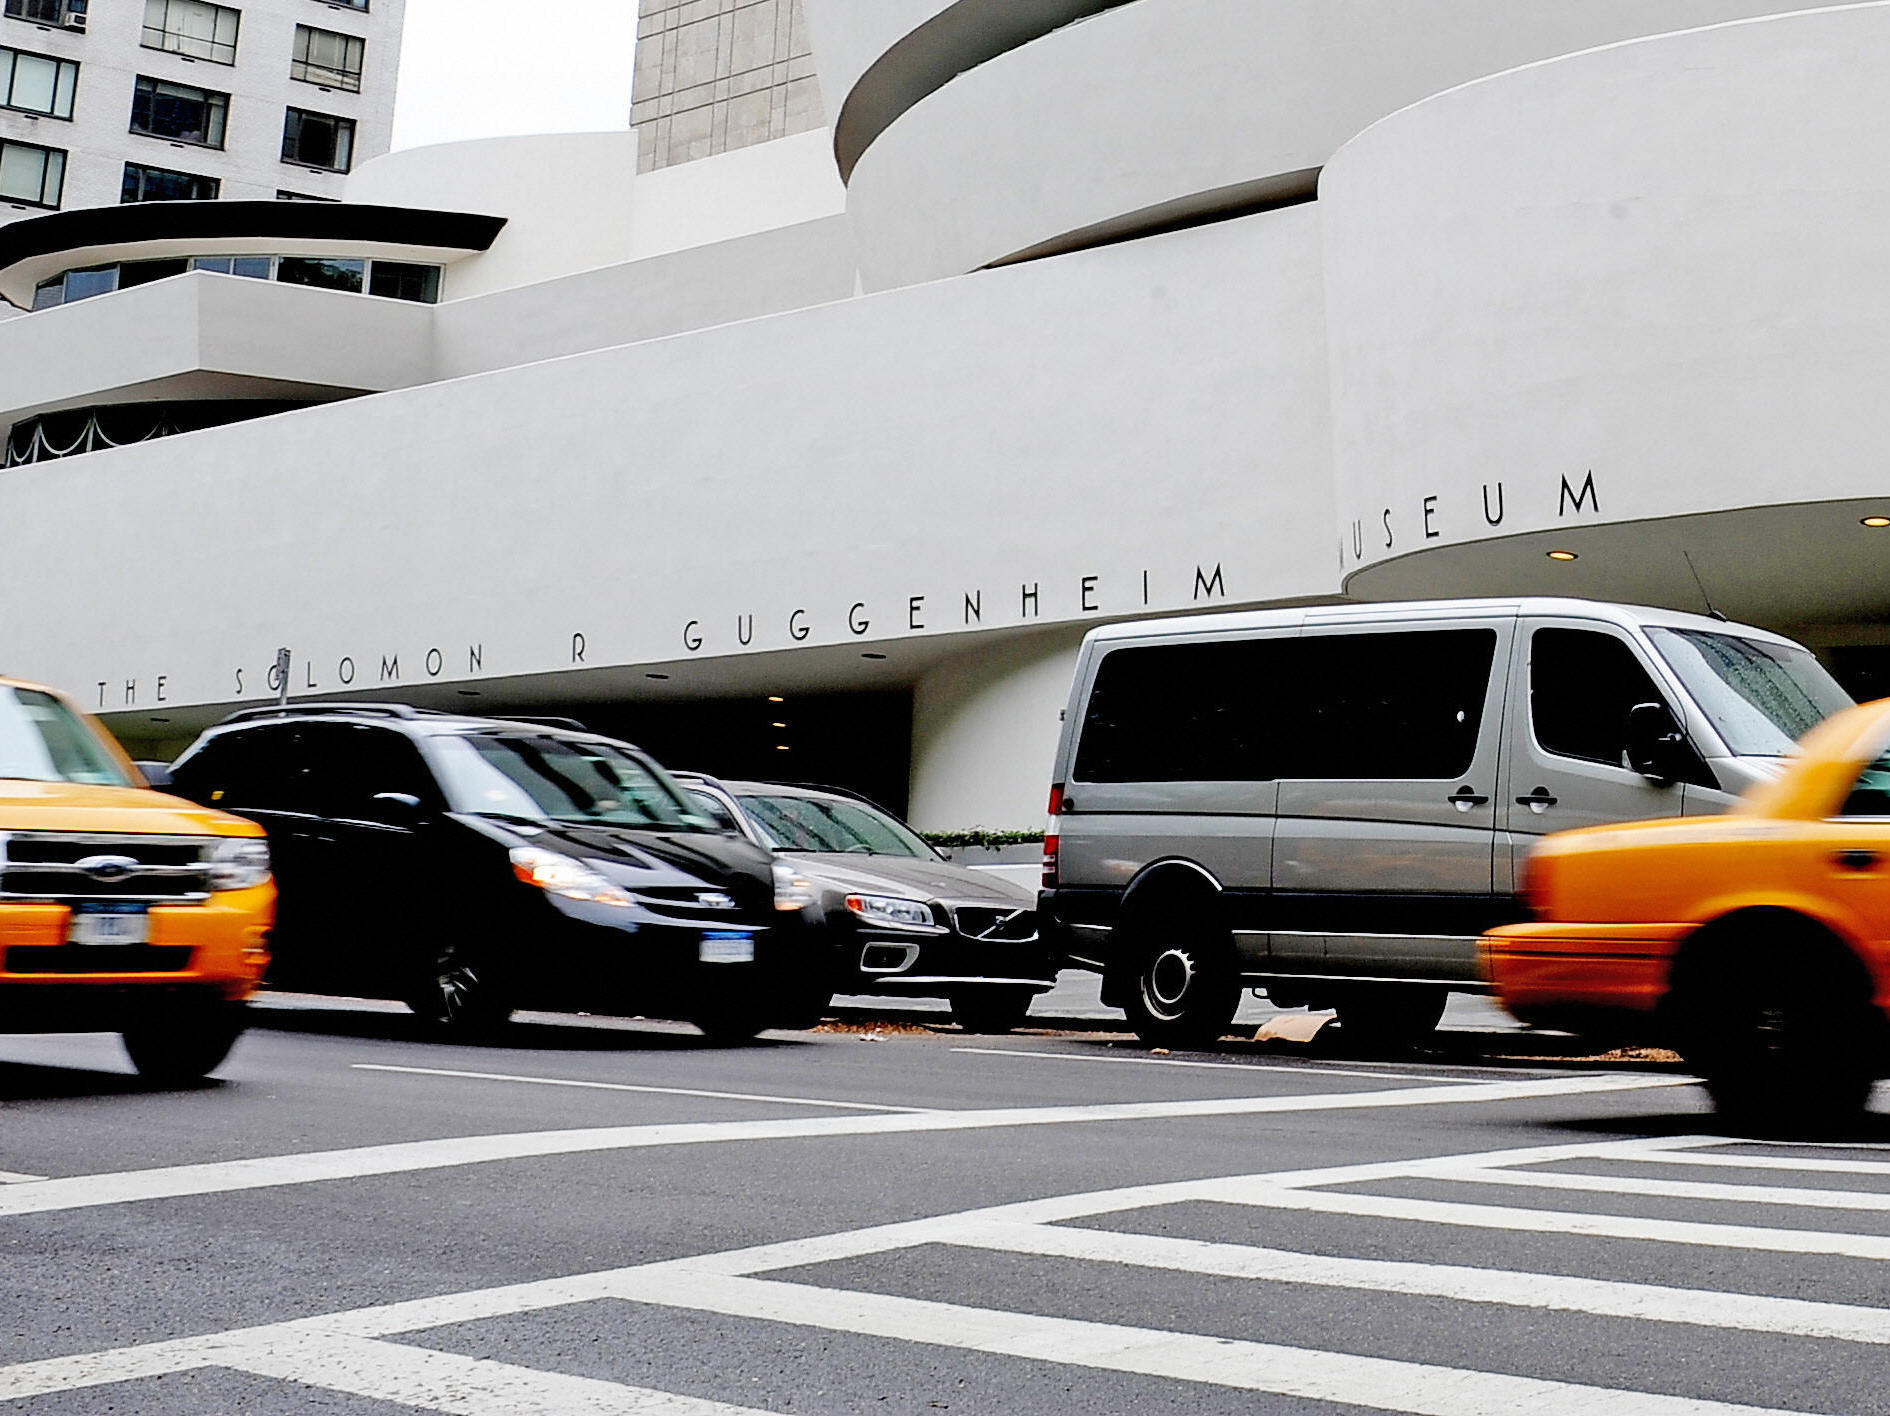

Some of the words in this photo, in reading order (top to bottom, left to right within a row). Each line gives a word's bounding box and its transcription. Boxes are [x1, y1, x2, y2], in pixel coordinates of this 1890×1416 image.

[97, 675, 168, 707] THE
[235, 644, 483, 695] SOLOMON
[571, 632, 586, 663] R
[683, 562, 1225, 652] GUGGENHEIM
